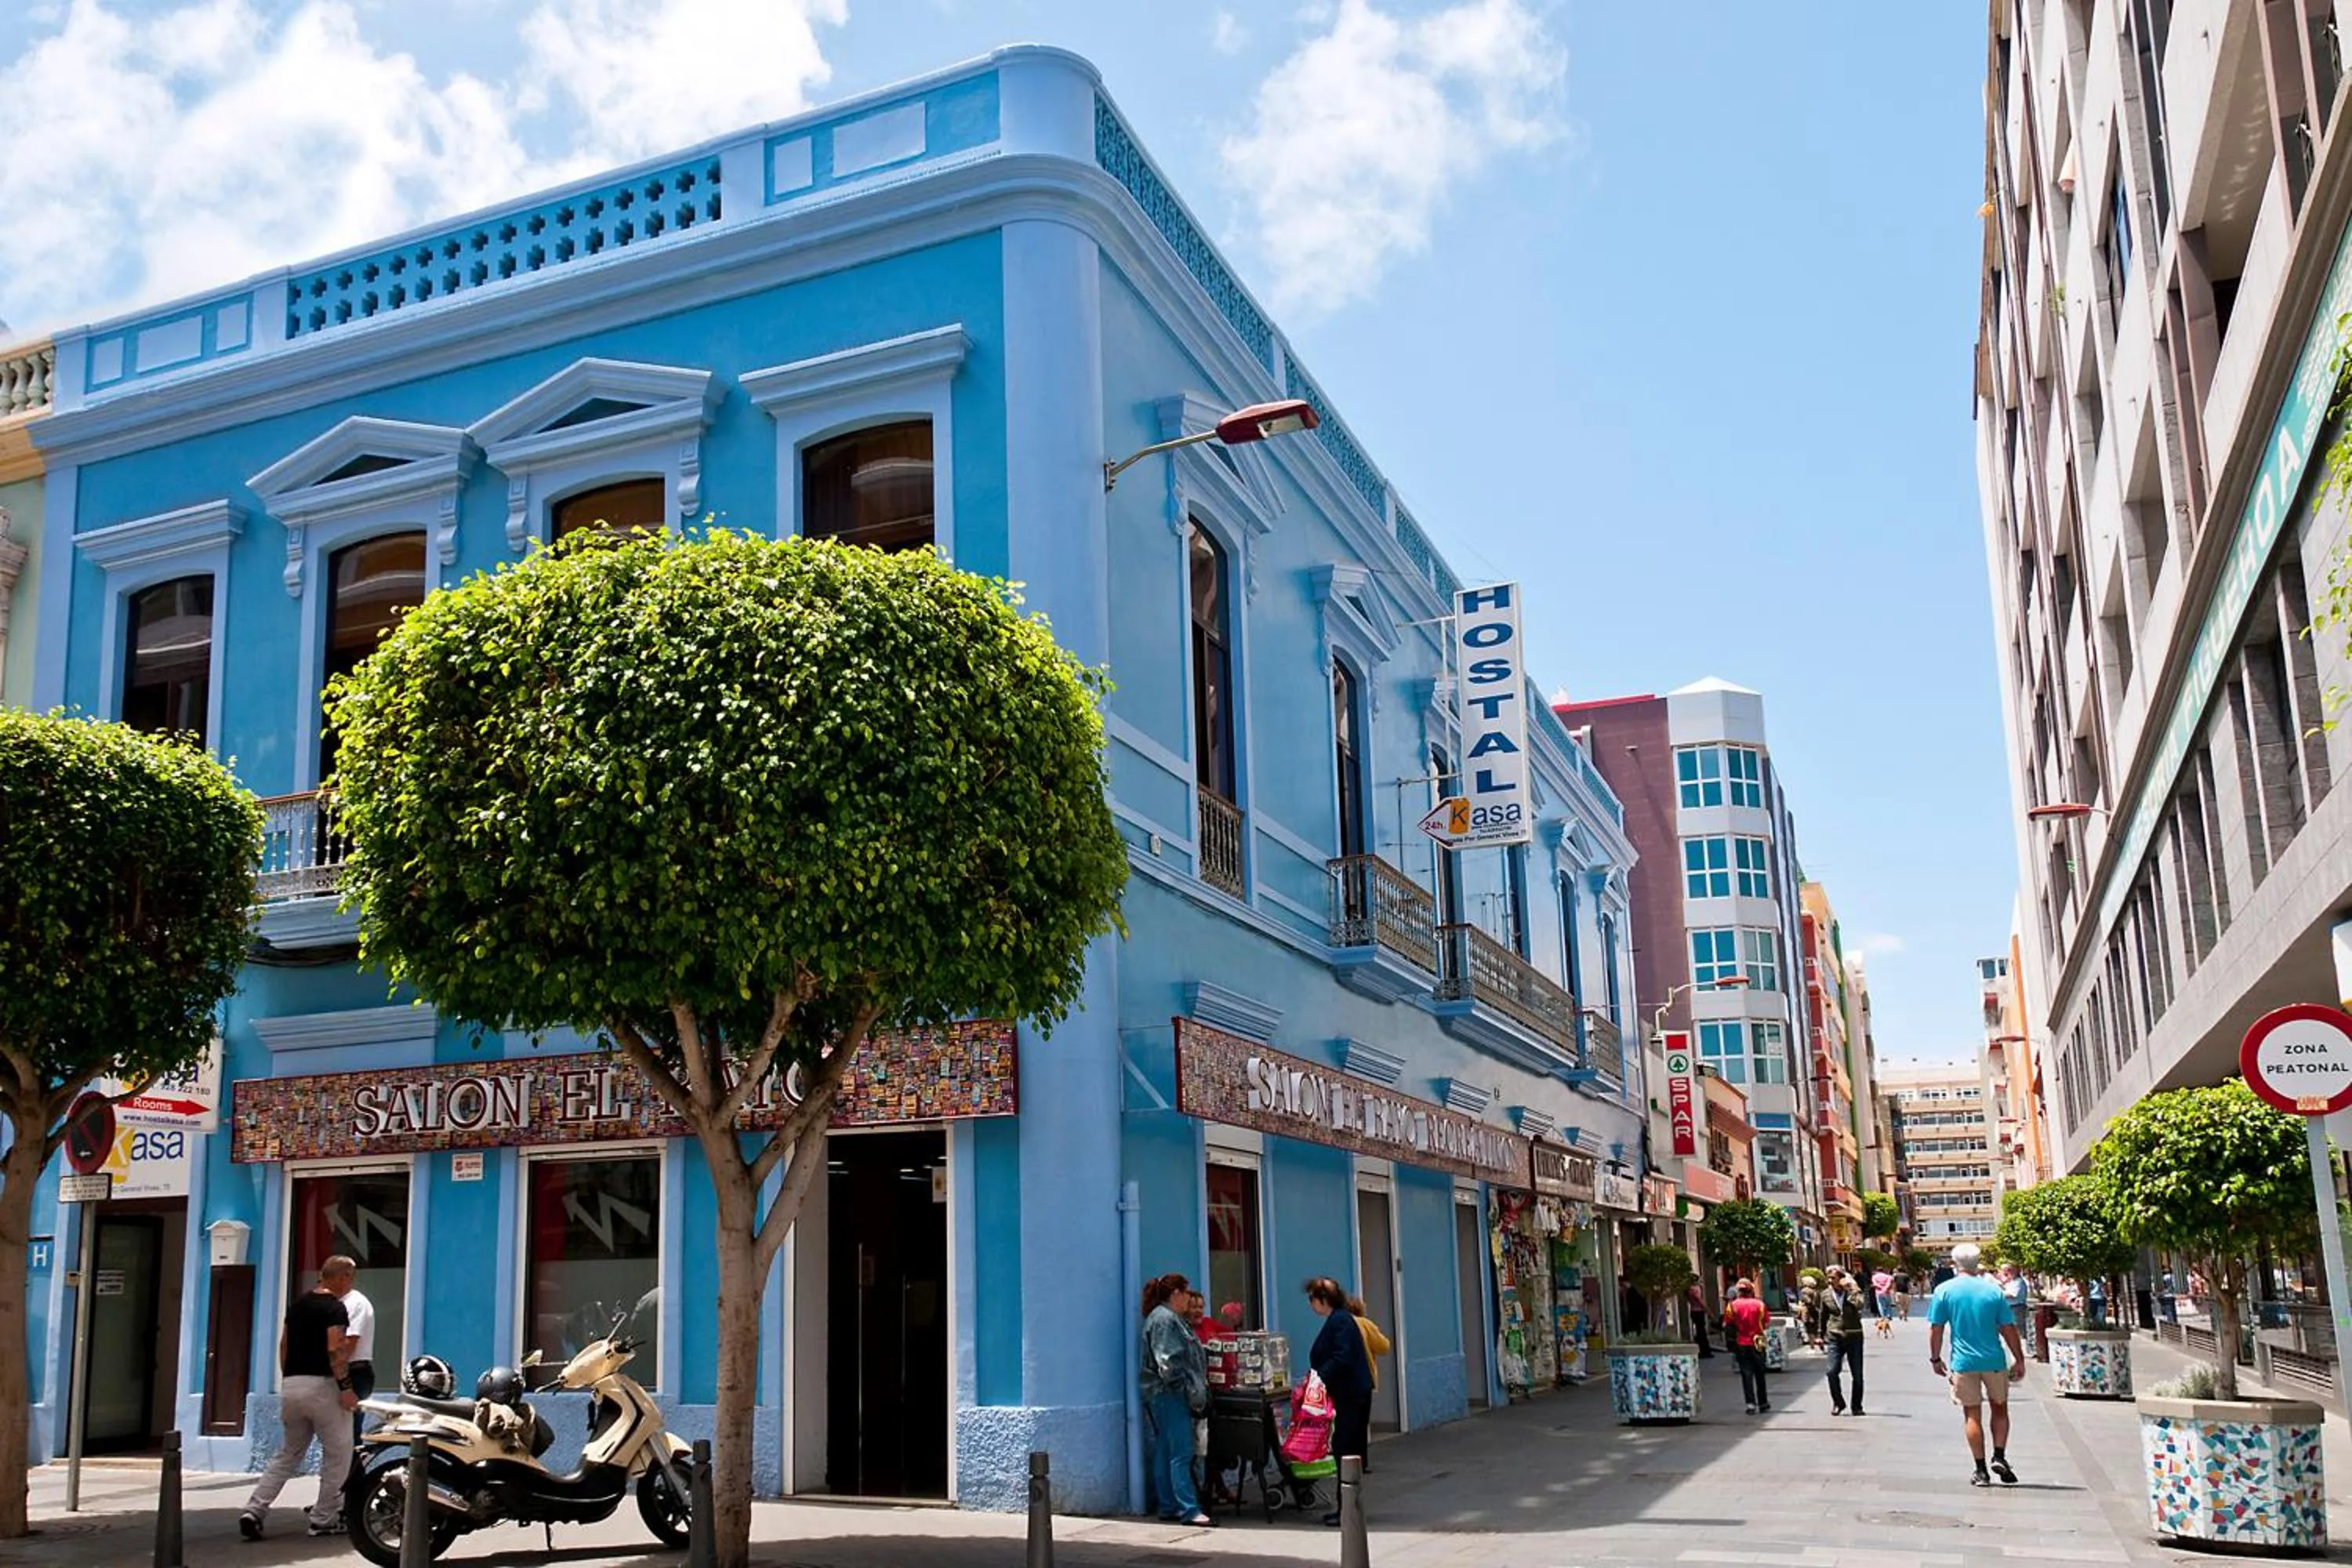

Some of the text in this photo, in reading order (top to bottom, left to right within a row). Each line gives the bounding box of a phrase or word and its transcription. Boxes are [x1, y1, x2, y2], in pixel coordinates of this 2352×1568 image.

[2183, 426, 2302, 735] FIGUEROA
[1462, 584, 1519, 794] HOSTAL
[1451, 803, 1522, 826] Kasa
[2267, 1062, 2350, 1074] PEATONAL
[2285, 1044, 2328, 1054] ZONA
[132, 1097, 173, 1111] Rooms
[352, 1073, 533, 1137] SALON
[557, 1068, 630, 1123] EL
[1248, 1057, 1331, 1124] SALON
[1330, 1083, 1363, 1133] EL
[1363, 1094, 1417, 1149] RAYO
[1671, 1078, 1692, 1138] SPAR
[33, 1244, 47, 1268] H
